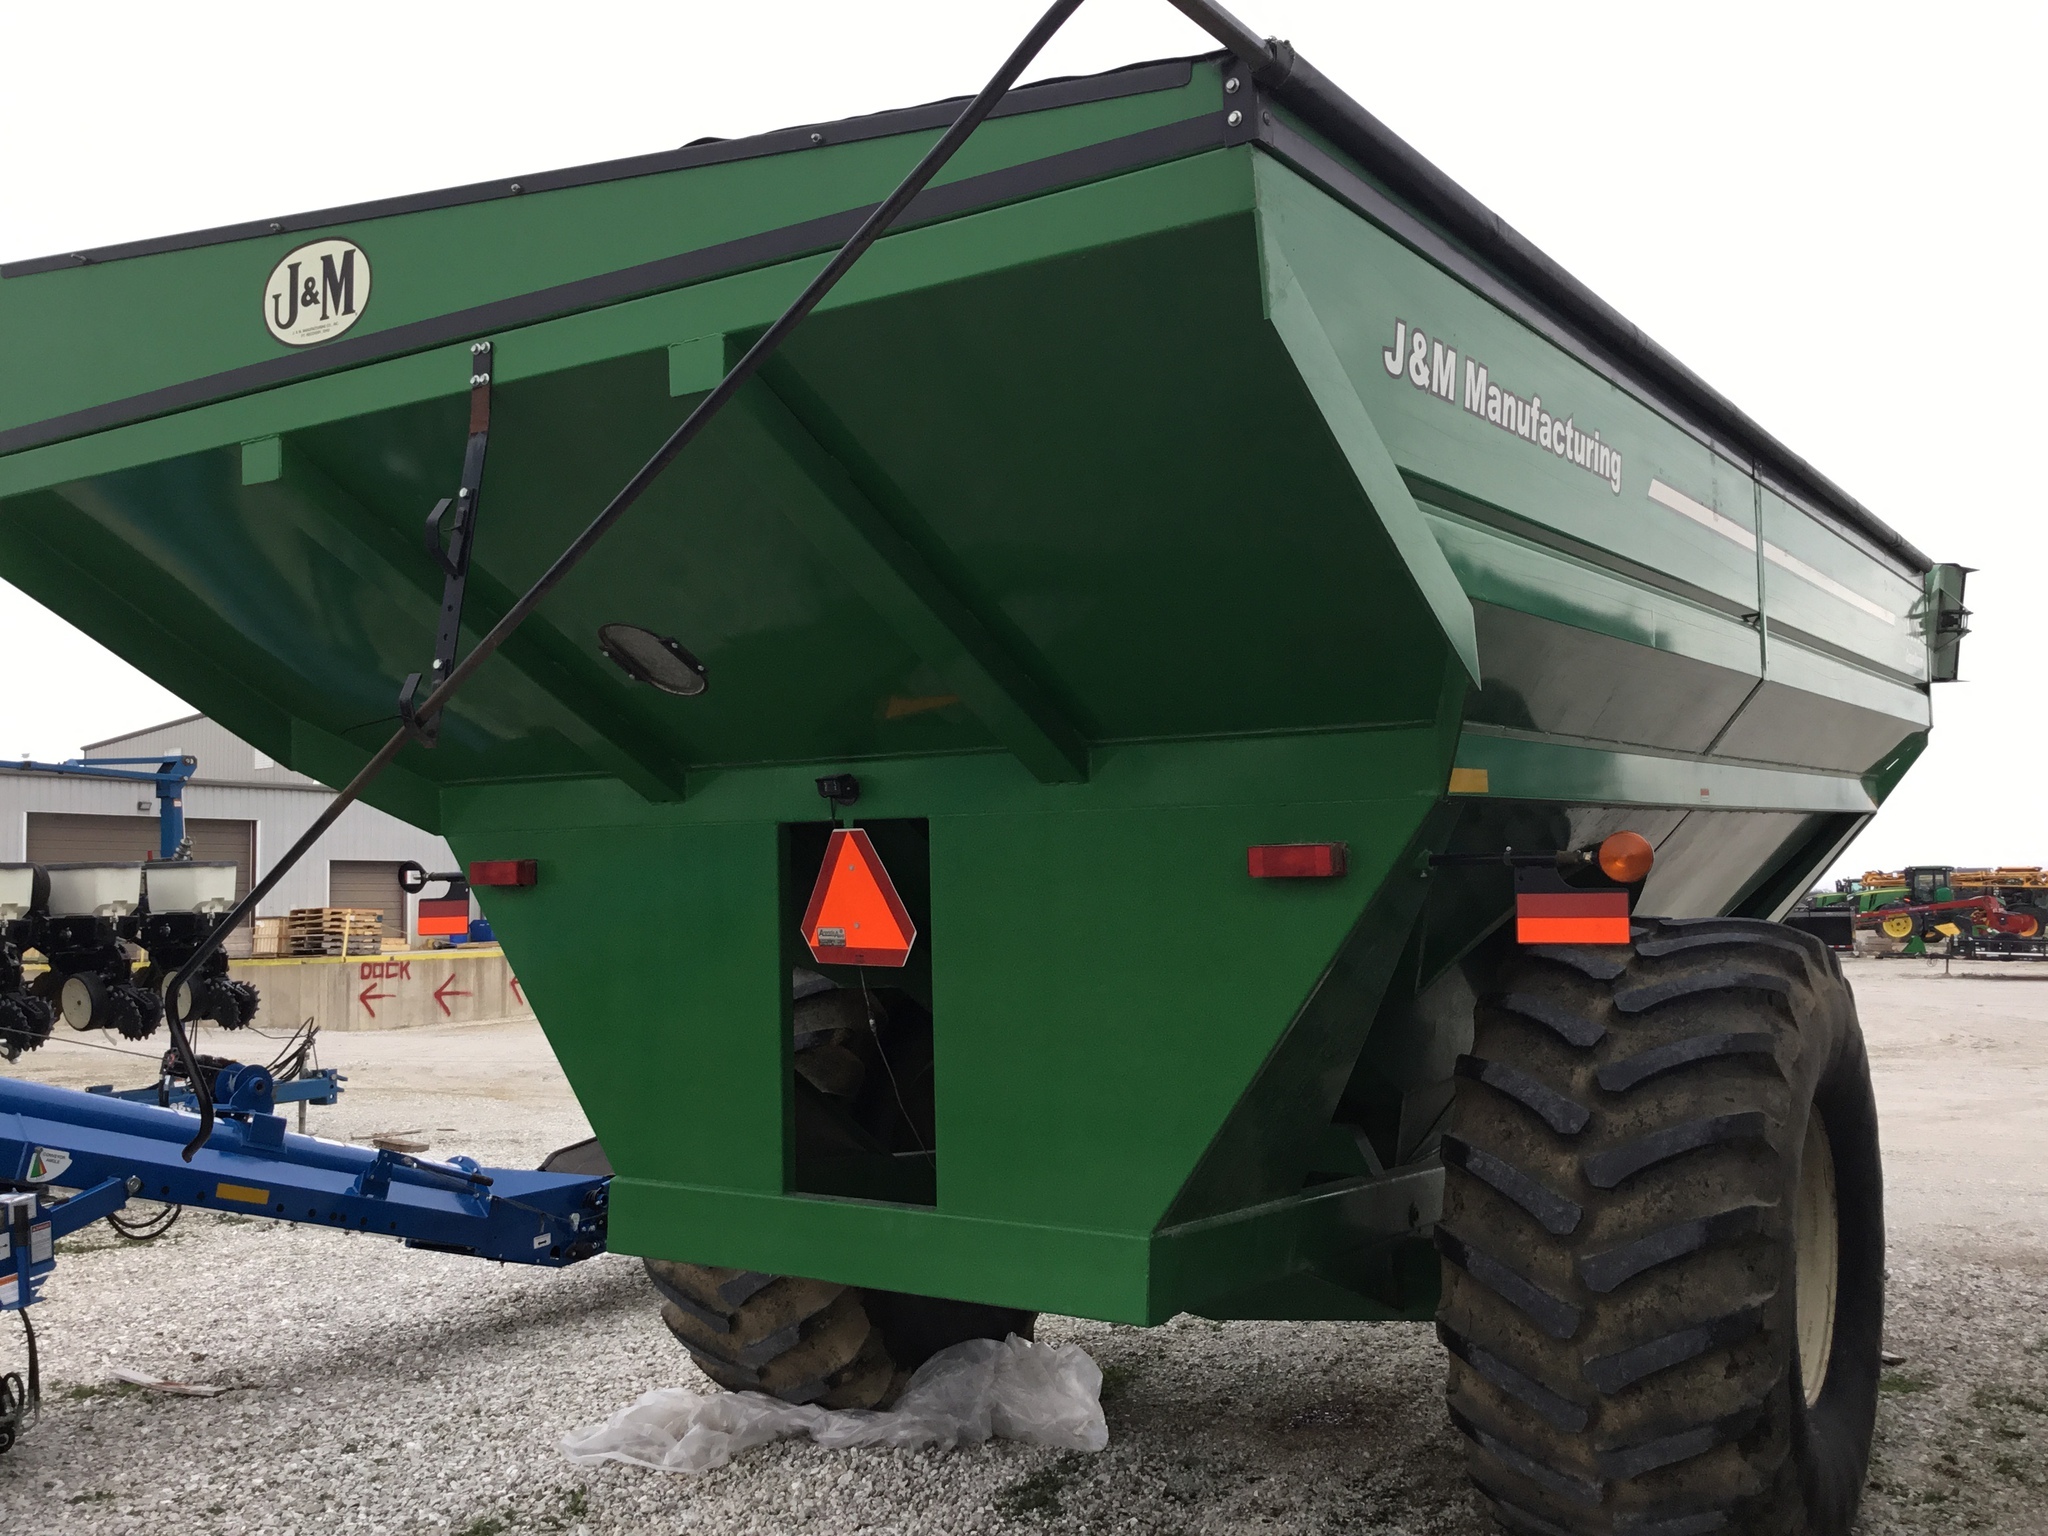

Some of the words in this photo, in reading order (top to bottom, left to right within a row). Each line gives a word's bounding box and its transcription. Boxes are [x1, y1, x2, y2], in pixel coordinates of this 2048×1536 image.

[272, 249, 357, 330] J&M
[1382, 317, 1457, 405] J&M
[1463, 355, 1623, 497] Manufacturing
[360, 961, 411, 980] DOCK
